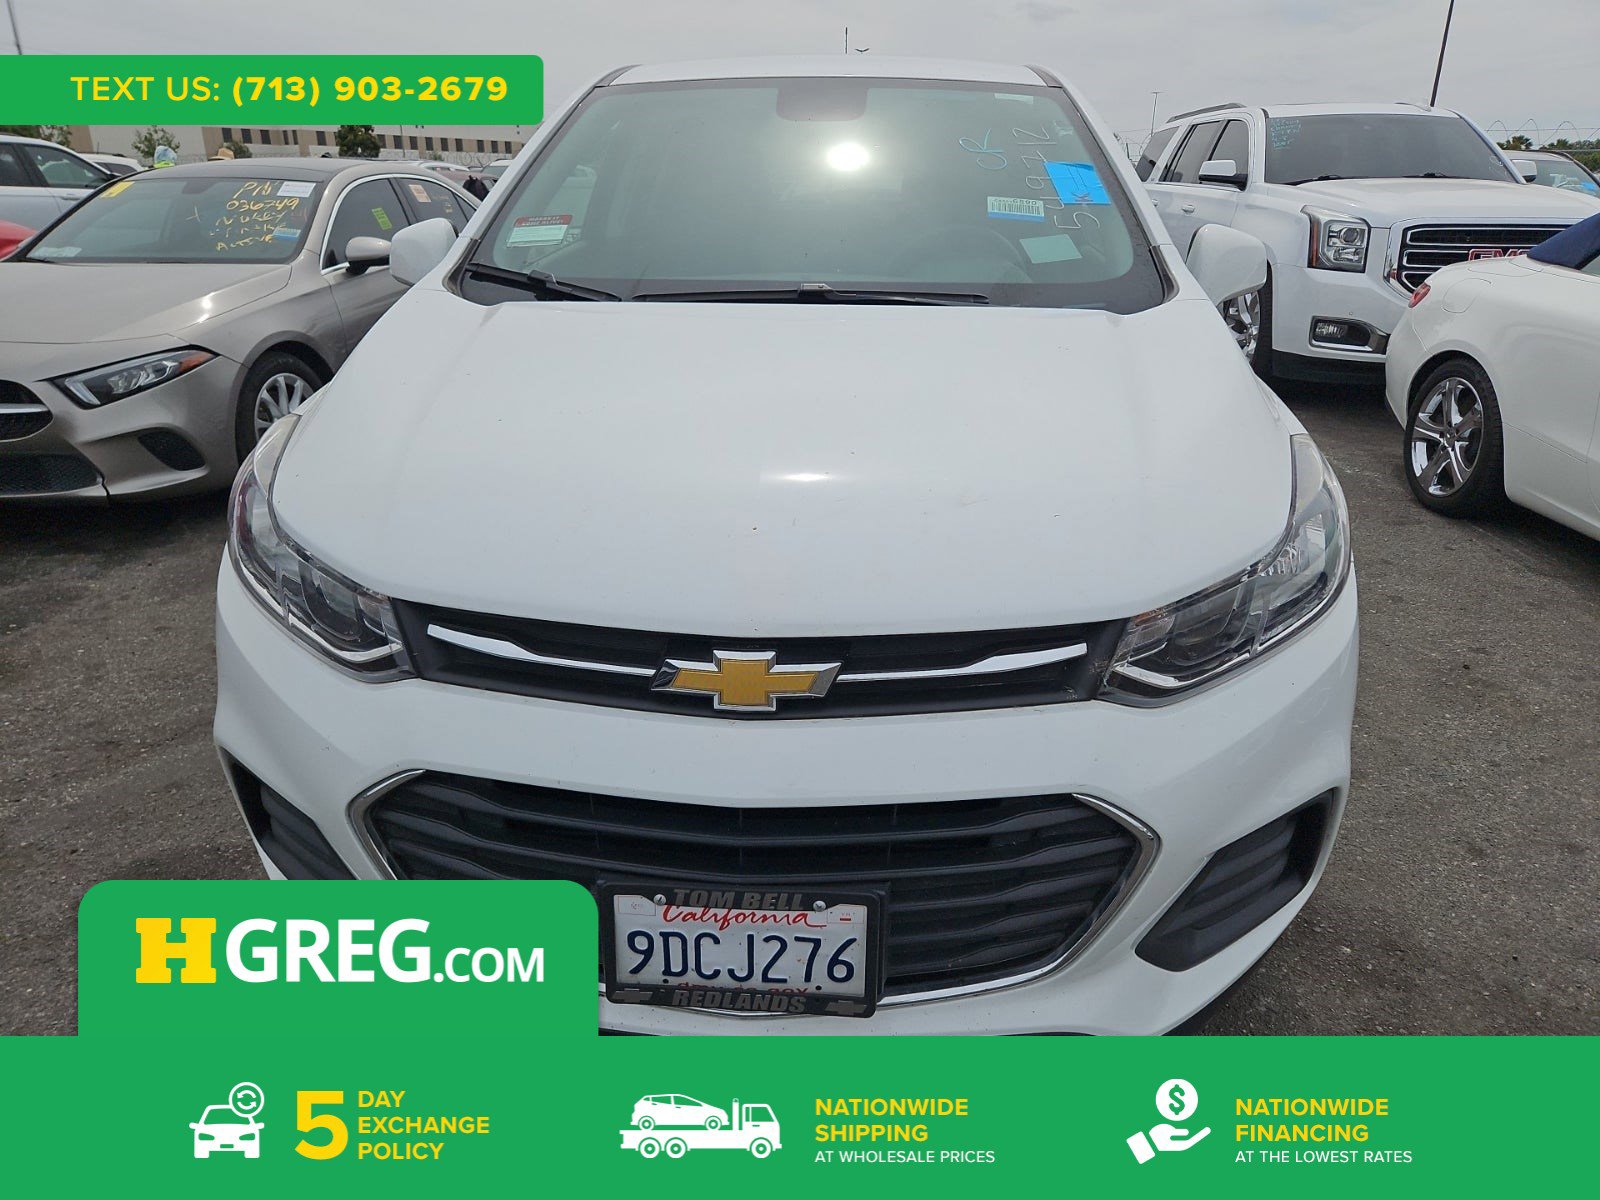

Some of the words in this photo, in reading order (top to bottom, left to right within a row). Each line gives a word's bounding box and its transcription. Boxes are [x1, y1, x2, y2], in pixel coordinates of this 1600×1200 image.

[226, 198, 300, 212] 036749
[1468, 249, 1530, 261] GM
[673, 887, 737, 909] TOM
[741, 891, 805, 912] BELL
[662, 904, 827, 931] California
[626, 929, 858, 984] 9DCJ276
[671, 990, 807, 1014] REDLANDS
